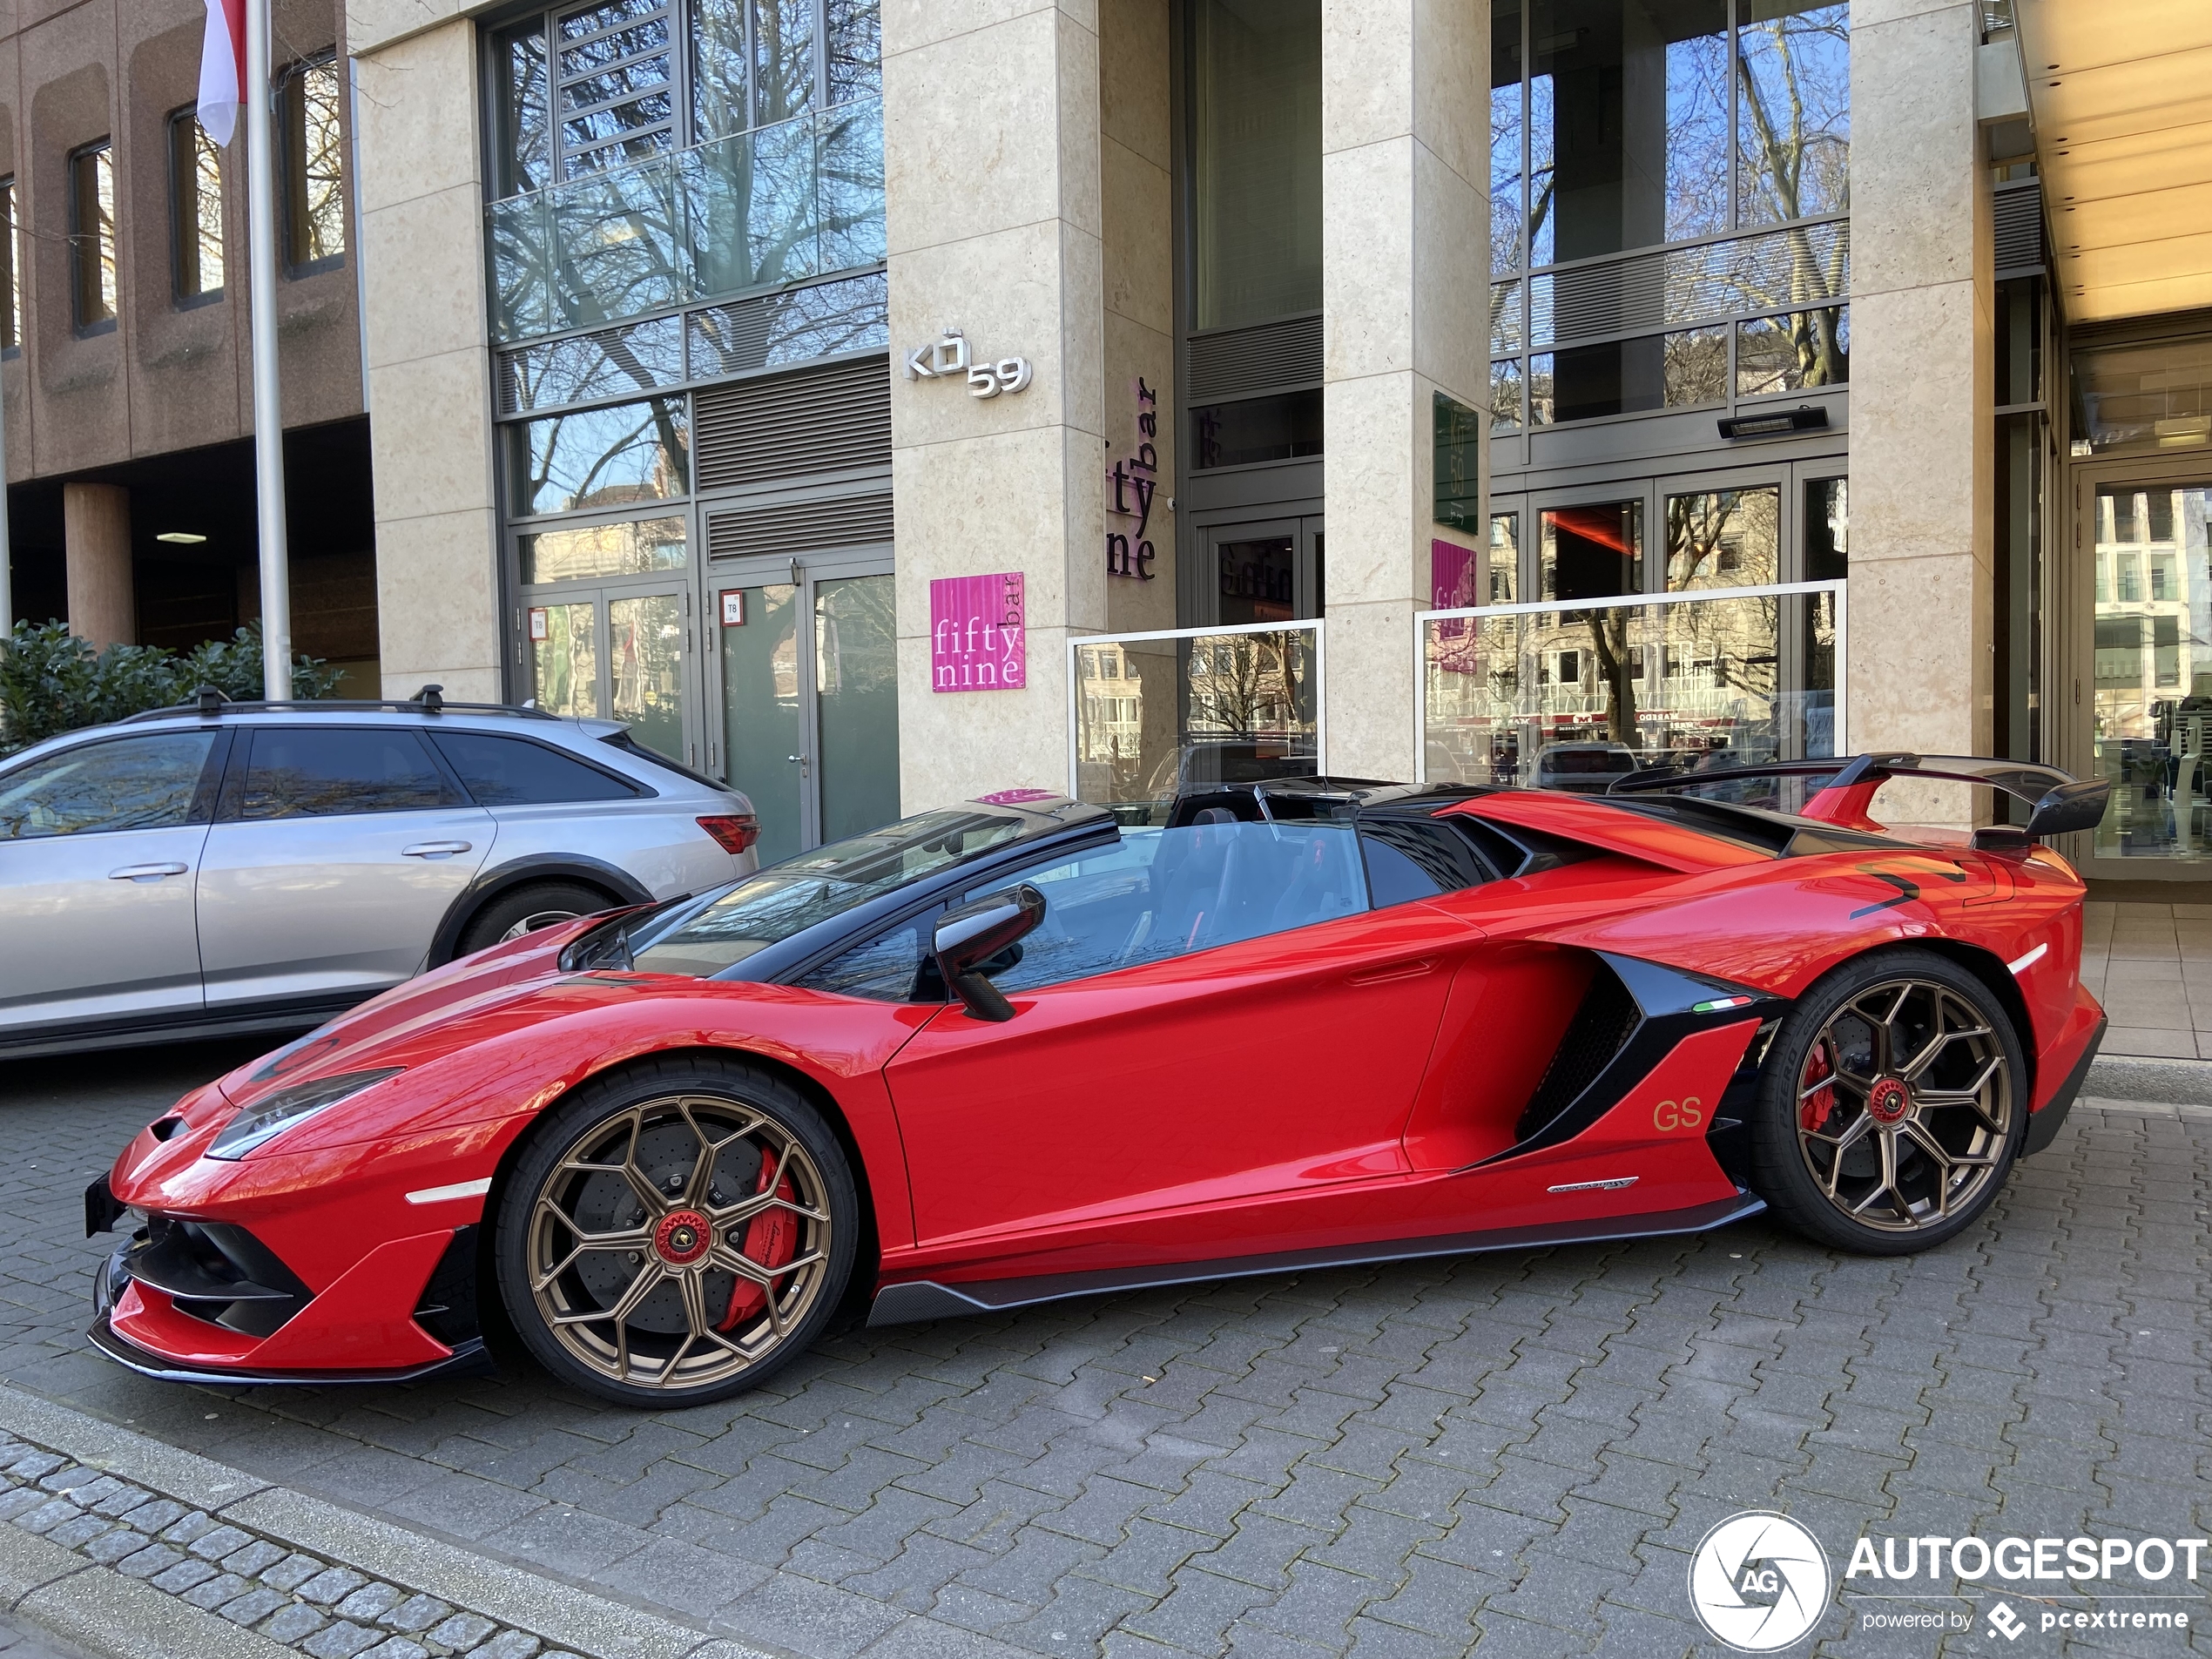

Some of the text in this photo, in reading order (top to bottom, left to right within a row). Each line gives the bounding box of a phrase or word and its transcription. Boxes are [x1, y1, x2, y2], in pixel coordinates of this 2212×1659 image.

[903, 327, 1032, 399] KÖ 59
[1130, 377, 1157, 473] bar
[1107, 533, 1155, 580] ne
[728, 604, 737, 613] T8
[997, 577, 1020, 628] bar
[535, 620, 543, 630] T8
[934, 616, 1021, 662] fifty
[936, 654, 1019, 686] nine
[1803, 998, 1832, 1036] CORSA
[1654, 1096, 1702, 1131] GS
